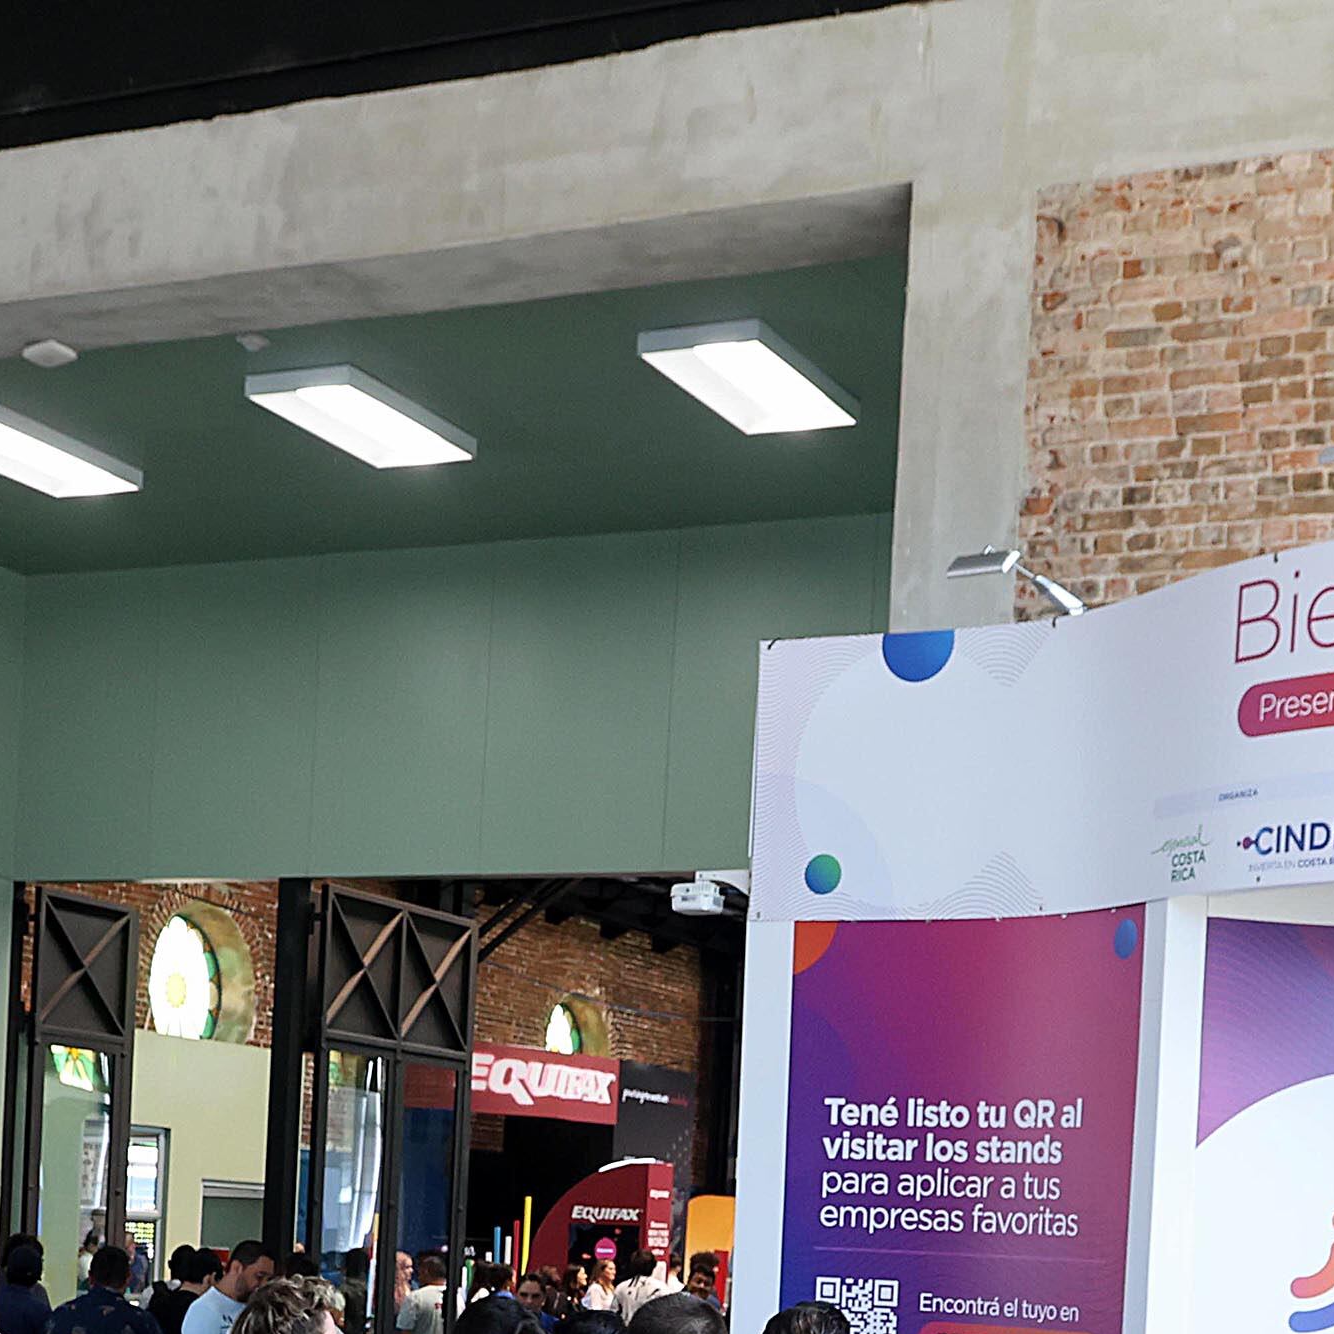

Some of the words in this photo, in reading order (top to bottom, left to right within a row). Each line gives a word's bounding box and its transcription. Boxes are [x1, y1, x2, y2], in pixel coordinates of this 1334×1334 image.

[1219, 788, 1259, 802] ORGANIZA
[1170, 867, 1196, 882] RICA
[1171, 850, 1207, 868] COSTA
[1297, 856, 1327, 868] COSTA
[470, 1052, 616, 1105] EQUIFAX
[824, 1096, 899, 1127] Tené
[907, 1098, 970, 1128] listo
[977, 1100, 1007, 1128] tu
[1014, 1098, 1056, 1129] QR
[1060, 1097, 1084, 1130] al
[822, 1131, 919, 1162] visitar
[925, 1133, 968, 1163] los
[975, 1134, 1063, 1165] stands
[821, 1170, 889, 1199] para
[897, 1168, 995, 1201] aplicar
[999, 1176, 1016, 1200] a
[1023, 1174, 1061, 1200] tus
[571, 1205, 640, 1223] EQUIFAX
[819, 1204, 965, 1234] empresas
[971, 1203, 1079, 1237] favoritas
[919, 1292, 1000, 1317] Encontrá
[1005, 1299, 1018, 1318] el
[1022, 1300, 1057, 1325] tuyo
[1060, 1306, 1079, 1323] en
